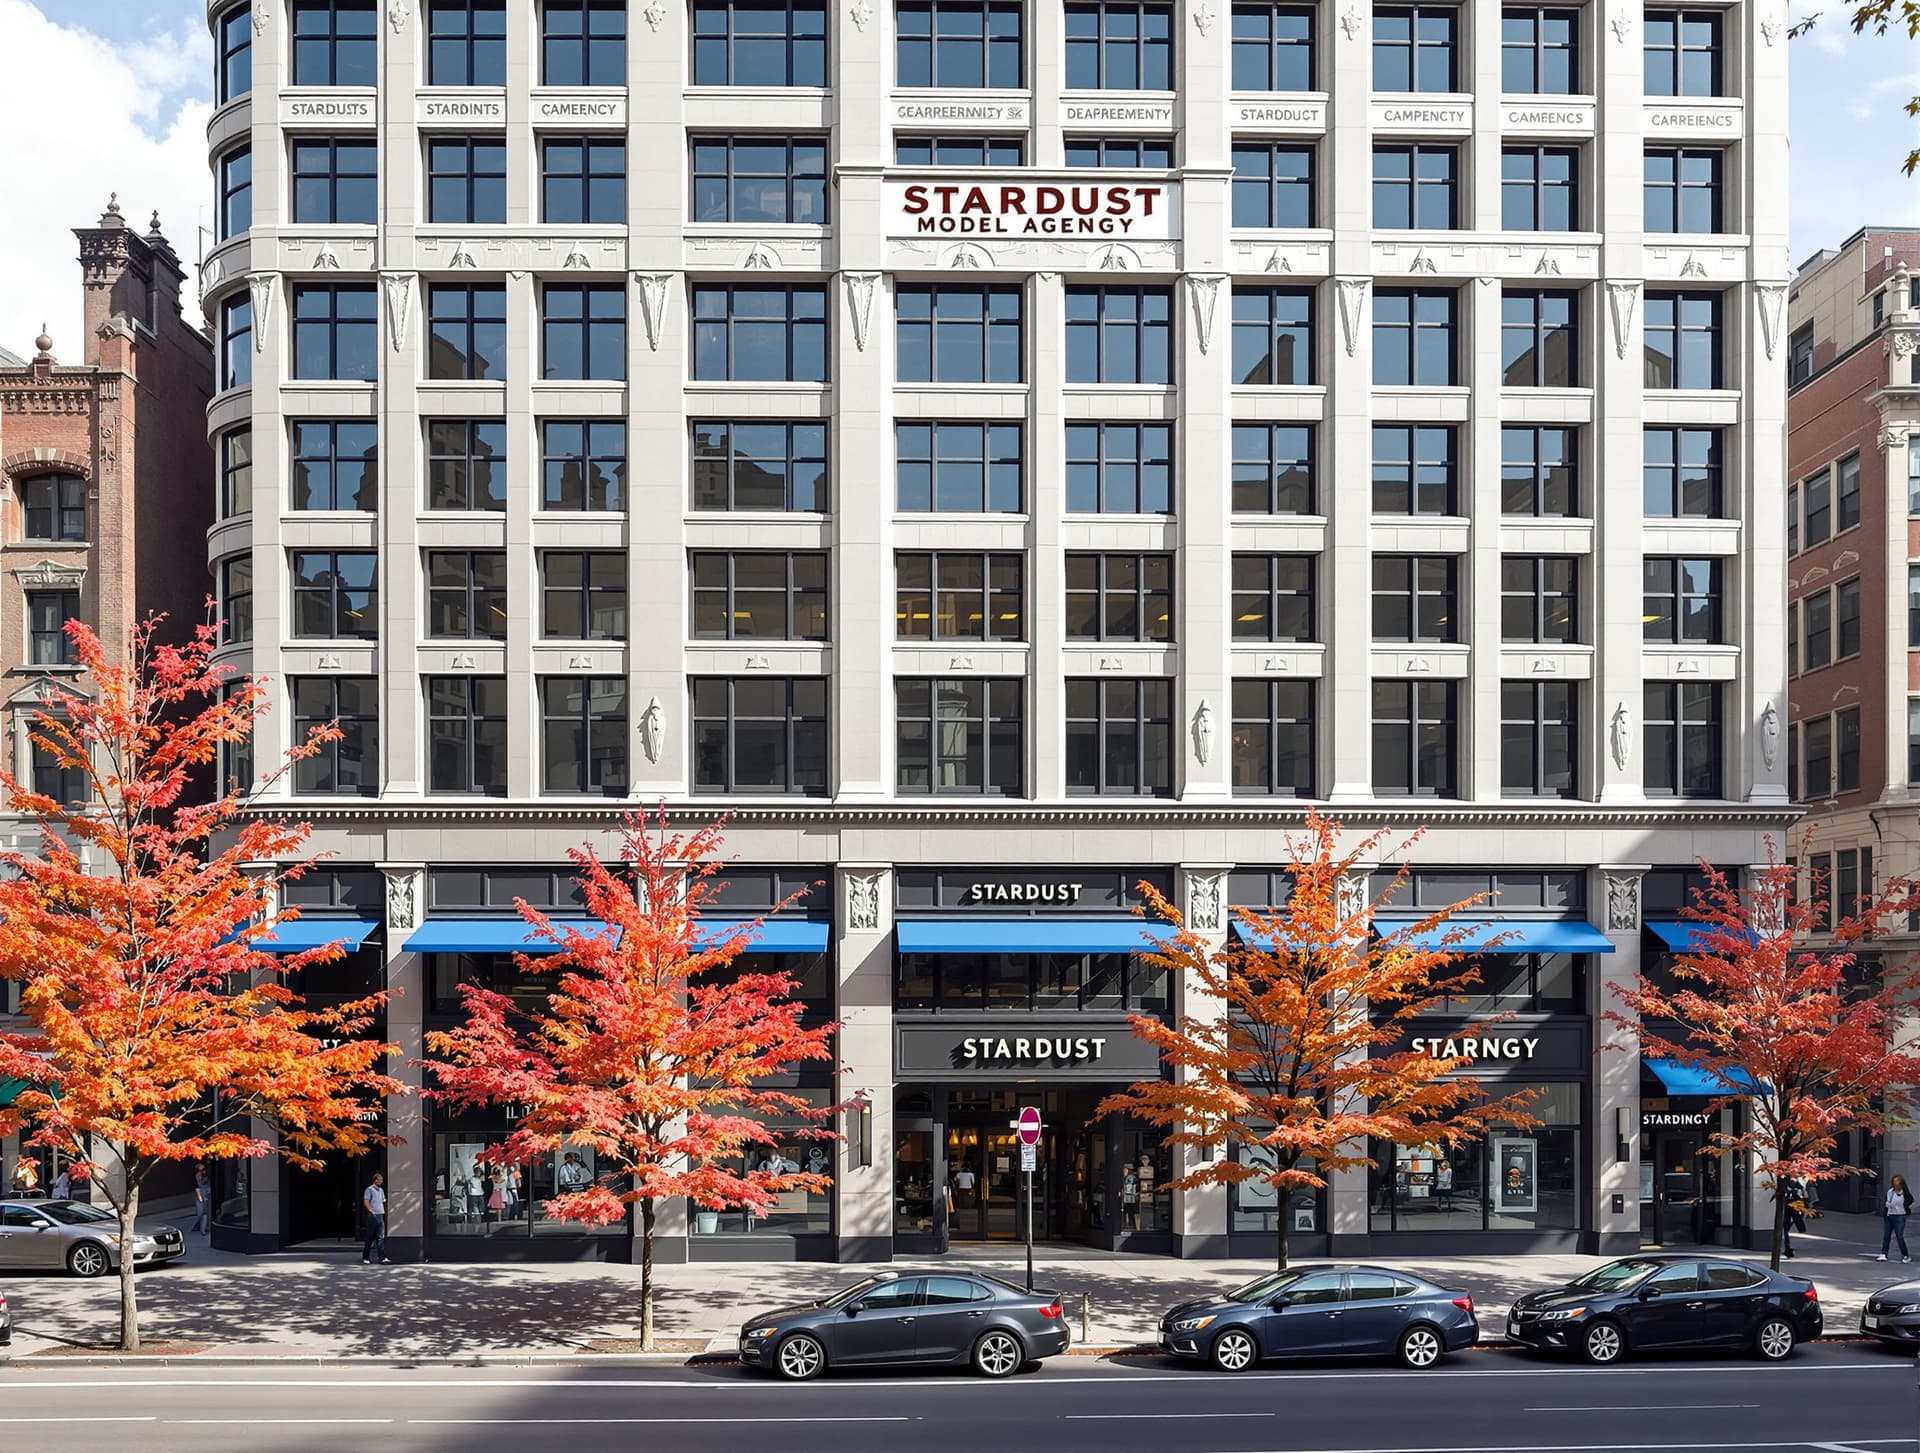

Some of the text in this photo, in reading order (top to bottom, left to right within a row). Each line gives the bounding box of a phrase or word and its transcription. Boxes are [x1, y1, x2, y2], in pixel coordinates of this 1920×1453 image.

[291, 103, 368, 116] STARDUSTS
[426, 103, 500, 116] STARDINTS
[541, 103, 617, 117] CAMEENCY
[1383, 109, 1465, 122] CAMPENCTY
[903, 185, 1161, 217] STARDUST
[917, 216, 1008, 233] MODEL
[970, 883, 1083, 901] STARDUST
[963, 1038, 1106, 1060] STARDUST
[1411, 1037, 1539, 1059] STARNGY
[1642, 1113, 1711, 1126] STARDINGY
